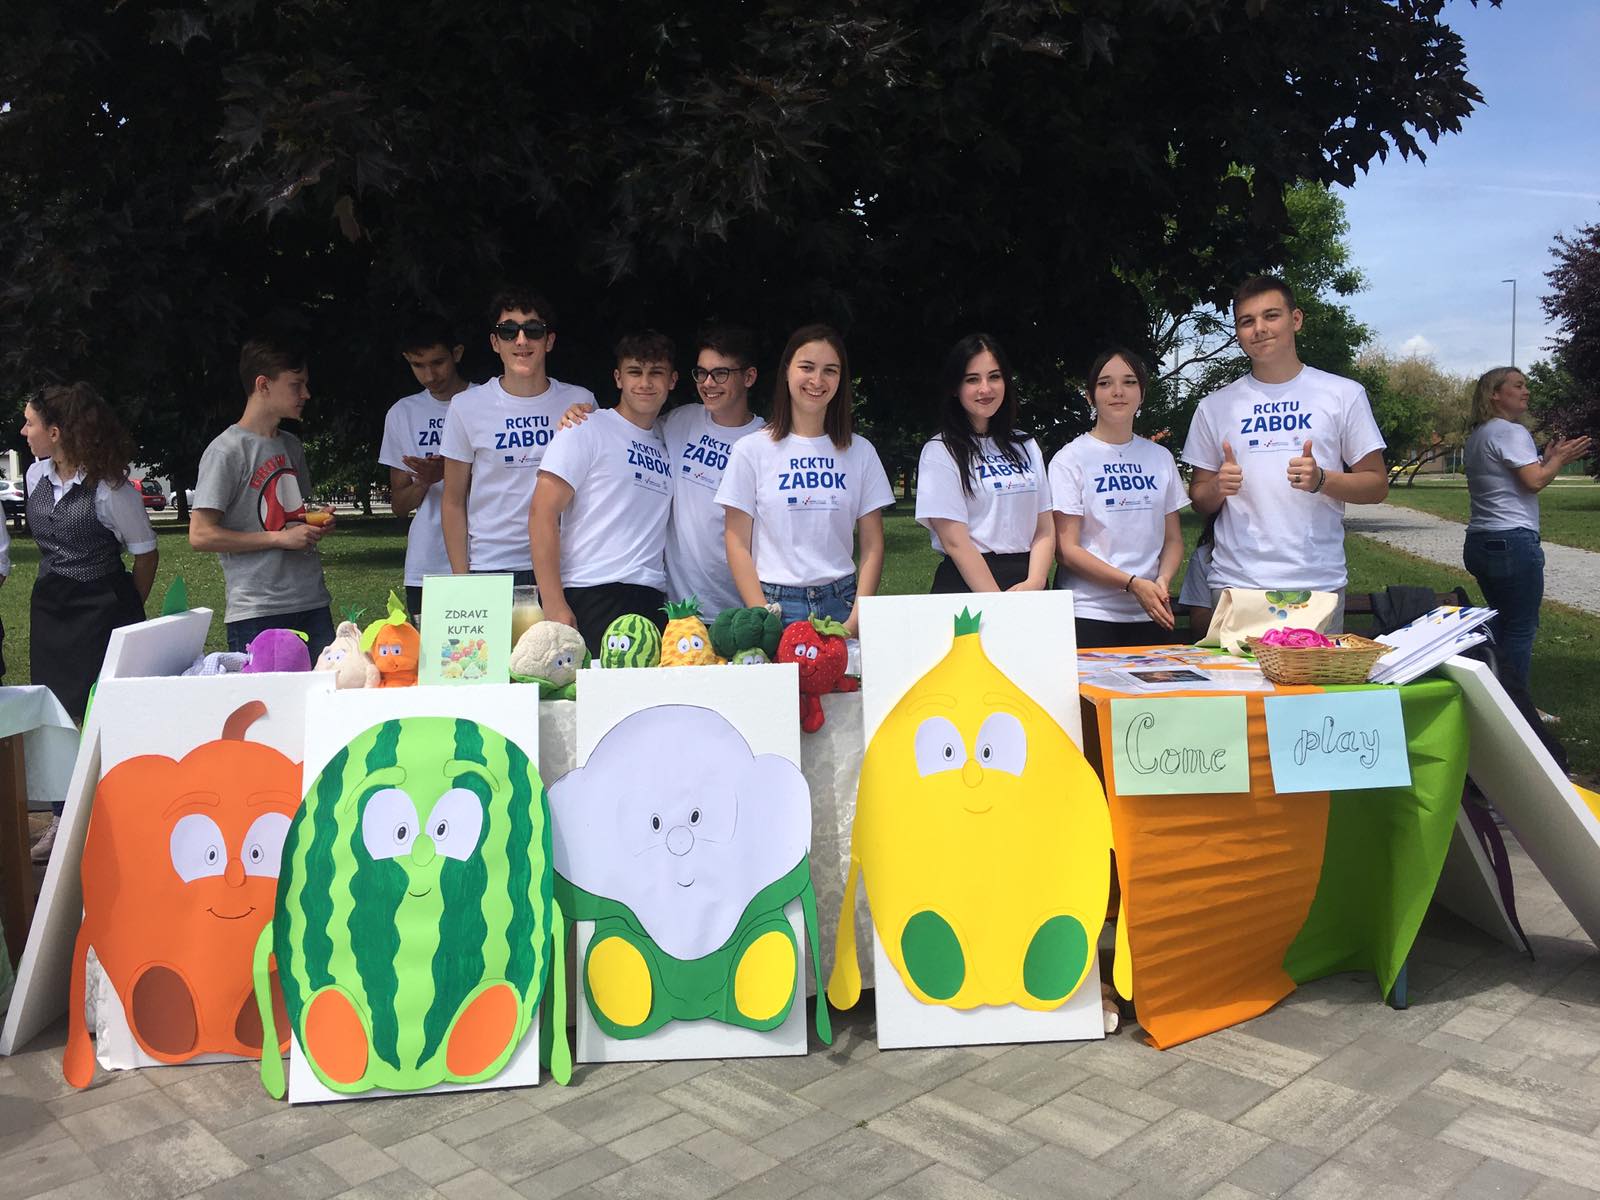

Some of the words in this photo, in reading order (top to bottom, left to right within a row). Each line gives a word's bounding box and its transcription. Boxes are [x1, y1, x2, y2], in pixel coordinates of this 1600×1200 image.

[1253, 401, 1300, 415] RCKTU
[429, 418, 445, 429] RC
[505, 415, 550, 430] RCKTU
[1240, 413, 1312, 434] ZABOK
[418, 431, 443, 446] ZA
[631, 440, 662, 458] RCKTU
[682, 443, 728, 471] ZABO
[627, 449, 672, 479] ZABOK
[790, 457, 834, 470] RCKTU
[1103, 463, 1142, 475] RCKTU
[778, 472, 847, 490] ZABOK
[1094, 475, 1158, 493] ZABOK
[444, 609, 488, 619] ZDRAVI
[447, 625, 485, 635] KUTAK
[1125, 711, 1226, 775] Come
[1293, 715, 1380, 769] play
